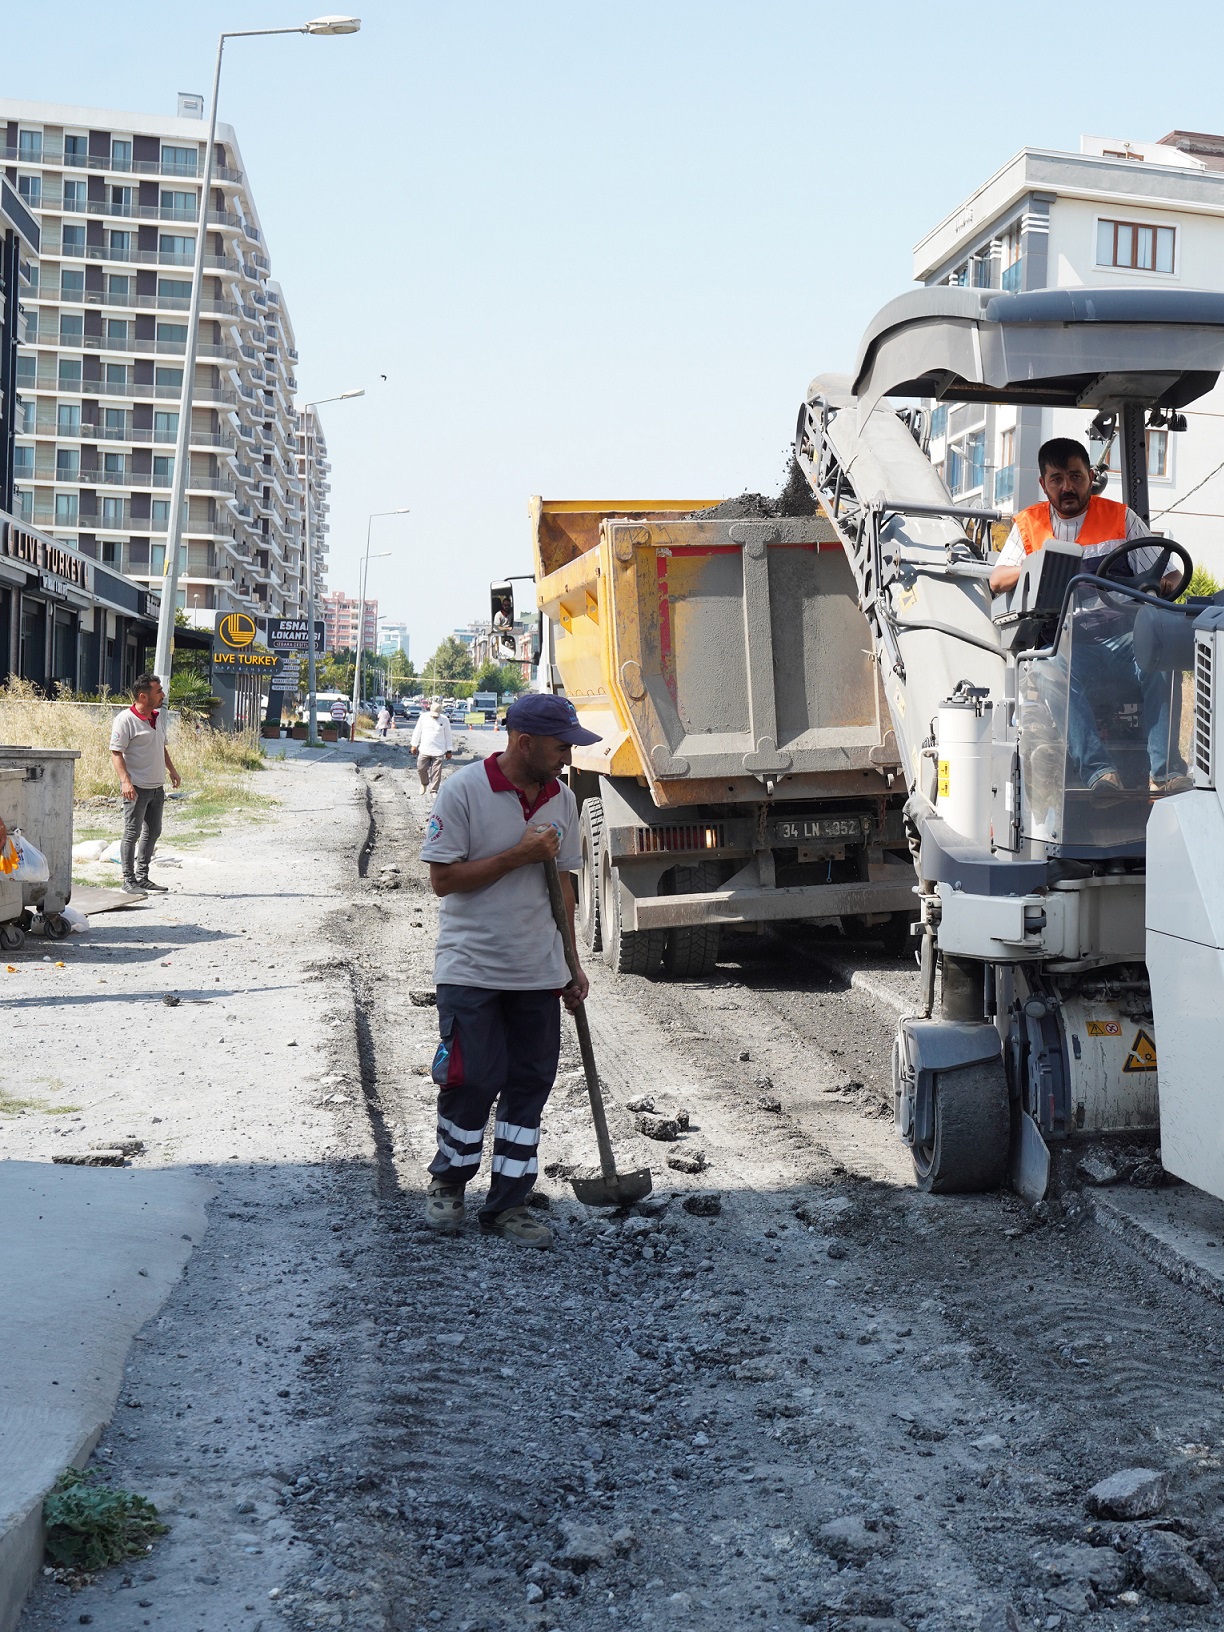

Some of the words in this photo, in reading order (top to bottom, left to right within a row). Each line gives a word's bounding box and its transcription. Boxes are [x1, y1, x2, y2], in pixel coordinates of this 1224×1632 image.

[18, 530, 42, 566] LIVE
[46, 543, 82, 583] TURKEY
[279, 620, 309, 631] ESNA
[214, 653, 235, 663] LIVE
[238, 654, 279, 667] TURKEY
[783, 823, 799, 838] 34
[804, 822, 820, 837] LN
[825, 820, 856, 837] 352
